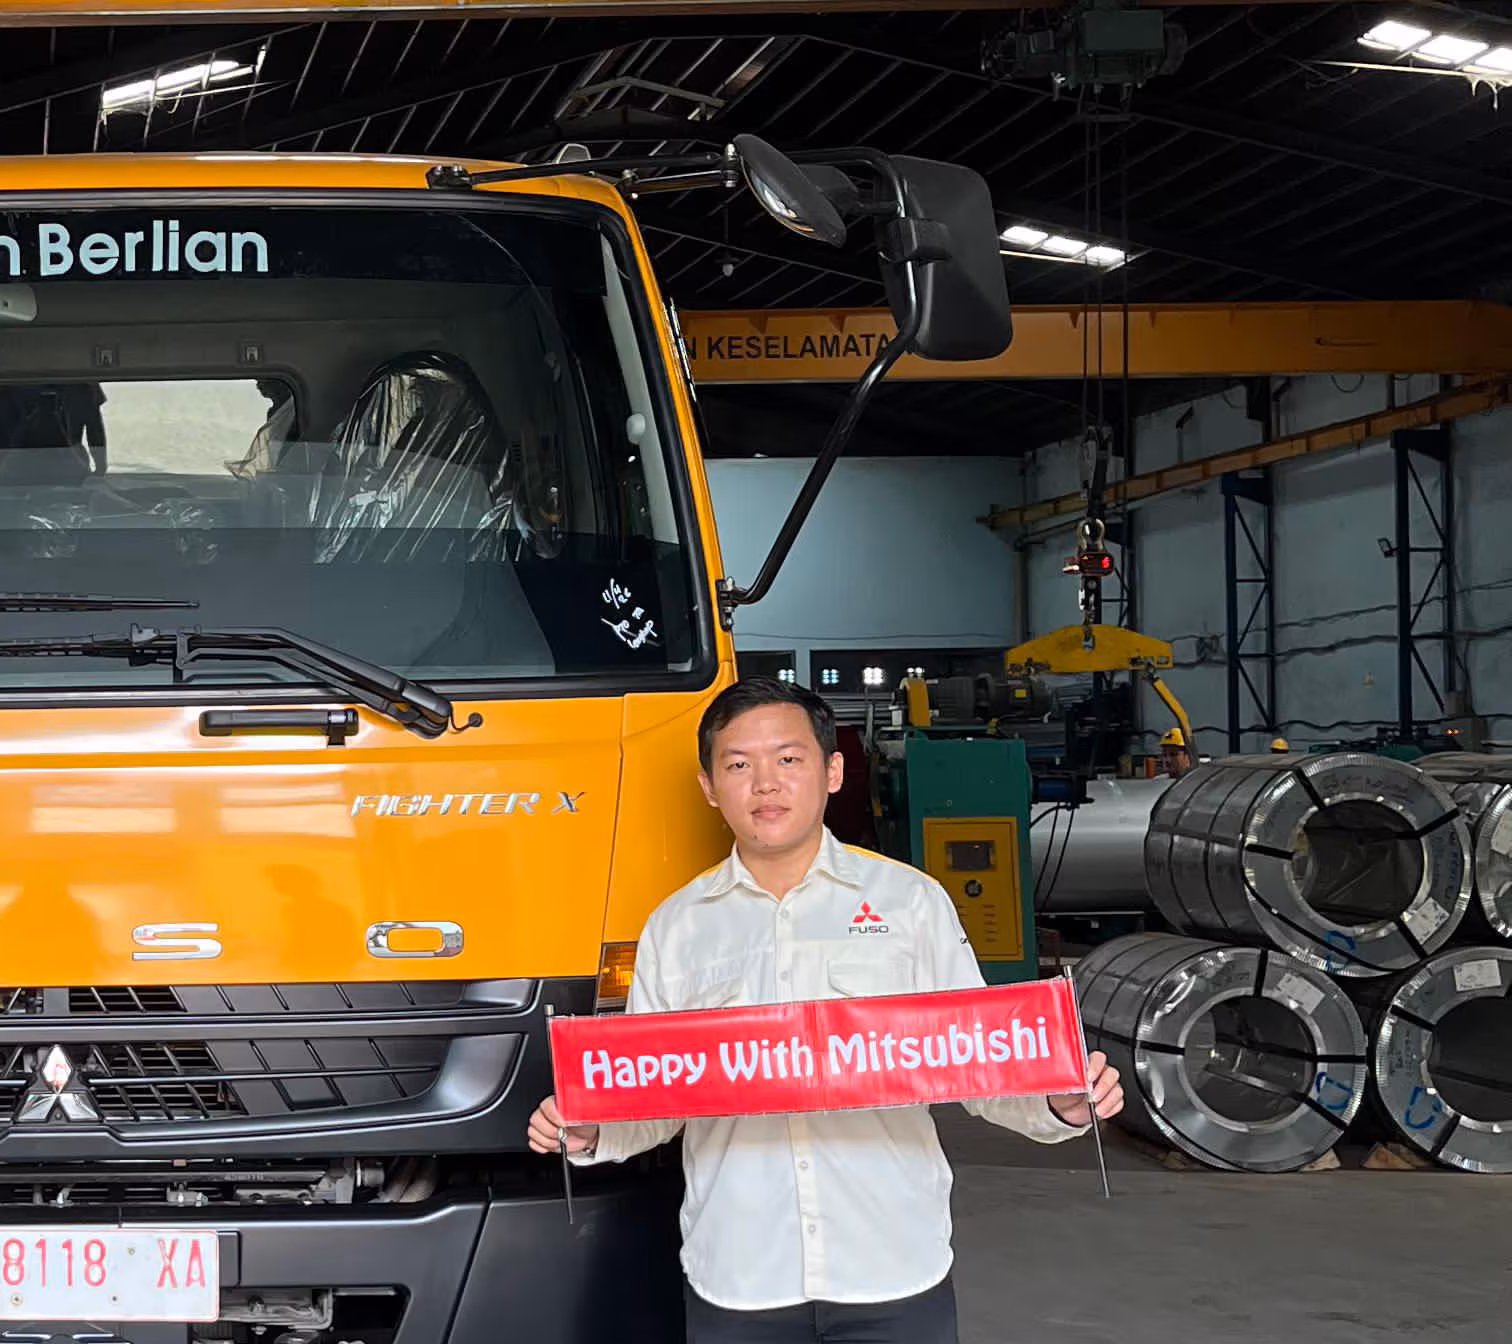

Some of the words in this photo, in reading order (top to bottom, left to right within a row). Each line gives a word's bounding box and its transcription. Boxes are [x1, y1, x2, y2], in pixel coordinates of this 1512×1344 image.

[39, 220, 269, 276] Berlian
[707, 333, 891, 360] KESELAMATA
[351, 792, 540, 817] FIGHTER
[551, 791, 587, 813] X
[848, 925, 889, 934] FUSO
[583, 1049, 708, 1089] Happy
[719, 1037, 814, 1082] With
[828, 1017, 1051, 1076] Mitsubishi
[2, 1238, 107, 1288] 8118
[156, 1238, 206, 1288] XA
